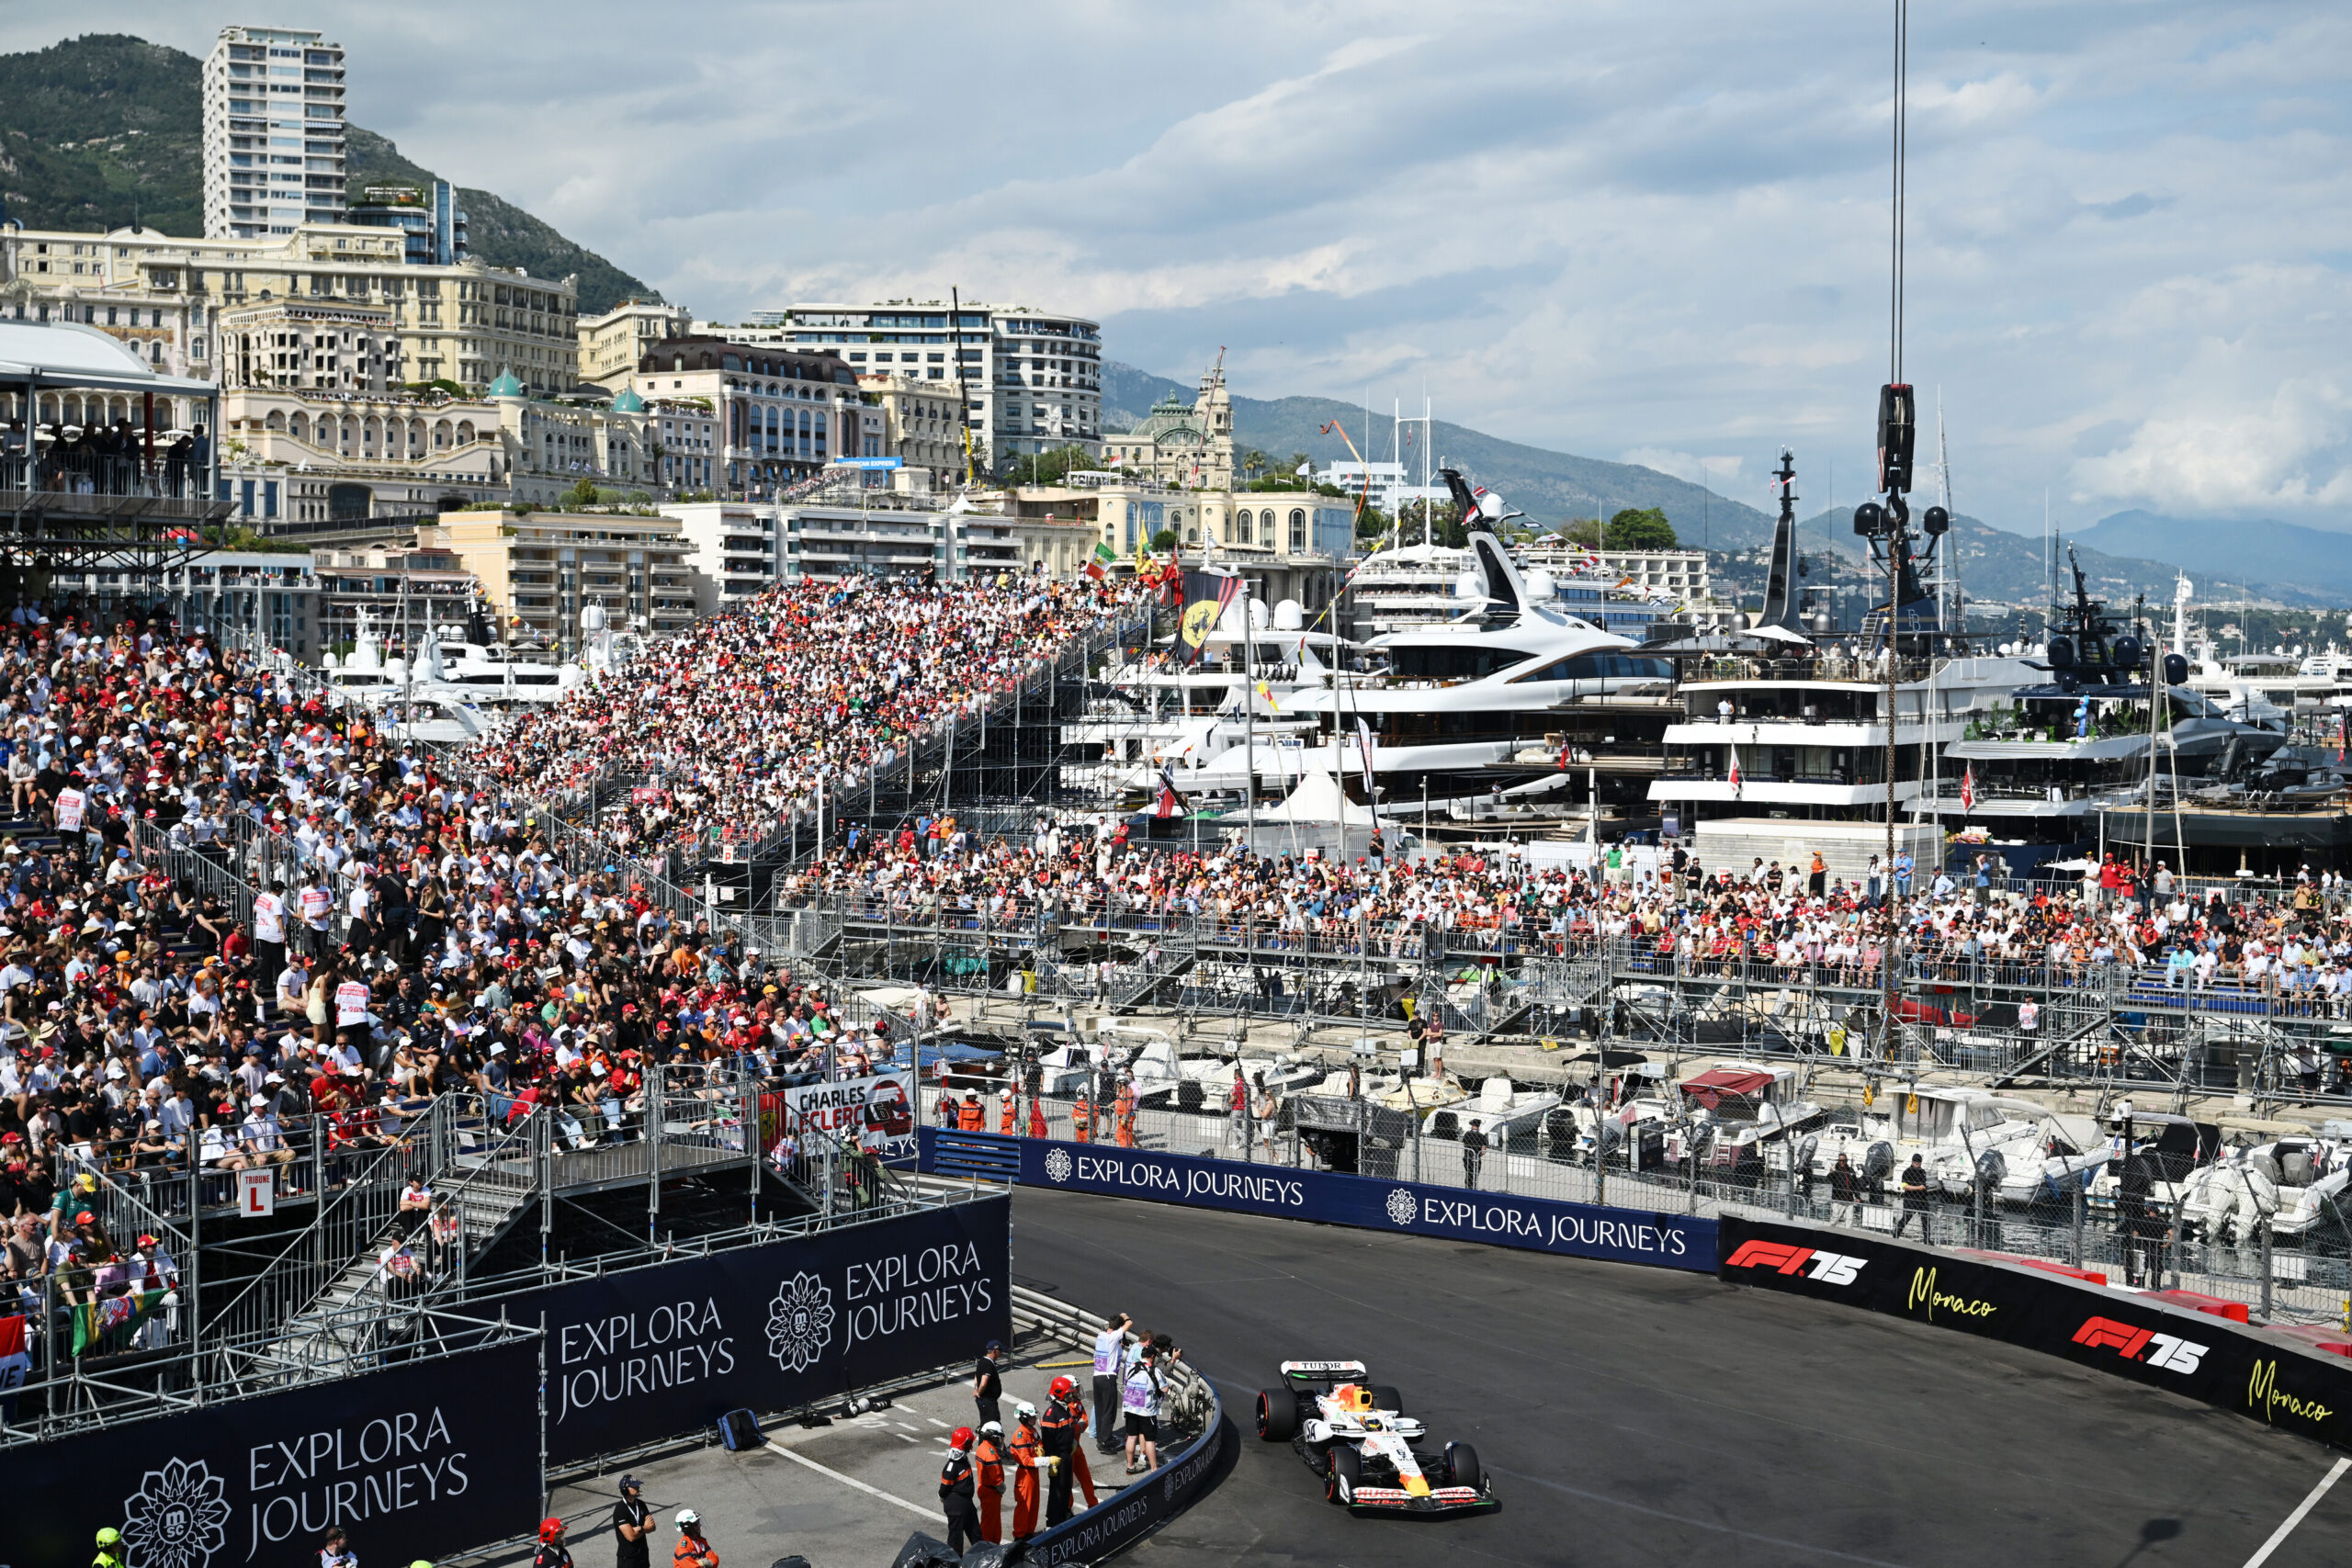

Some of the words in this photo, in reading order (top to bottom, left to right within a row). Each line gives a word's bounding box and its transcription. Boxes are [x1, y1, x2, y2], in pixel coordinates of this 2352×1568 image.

[789, 1105, 864, 1134] ECLERC
[799, 1086, 865, 1111] CHARLES
[245, 1175, 271, 1185] TRIBUNE
[250, 1187, 265, 1212] L
[1079, 1156, 1181, 1190] EXPLORA
[1185, 1169, 1304, 1205] JOURNEYS
[1424, 1198, 1543, 1237] EXPLORA
[1548, 1214, 1686, 1256] JOURNEYS
[847, 1240, 981, 1301] EXPLORA
[1909, 1267, 1997, 1321] Monaco
[561, 1296, 722, 1365] EXPLORA
[843, 1278, 991, 1356] JOURNEYS
[557, 1337, 734, 1425] JOURNEYS
[2248, 1359, 2334, 1422] Monaco
[251, 1406, 452, 1492] EXPLORA
[1175, 1454, 1205, 1491] EXPLORA
[245, 1453, 469, 1562] JOURNEYS
[1357, 1489, 1402, 1498] HUGO
[1438, 1487, 1473, 1497] HUGO
[1051, 1525, 1101, 1566] EXPLORA
[1102, 1495, 1148, 1544] JOURNEYS
